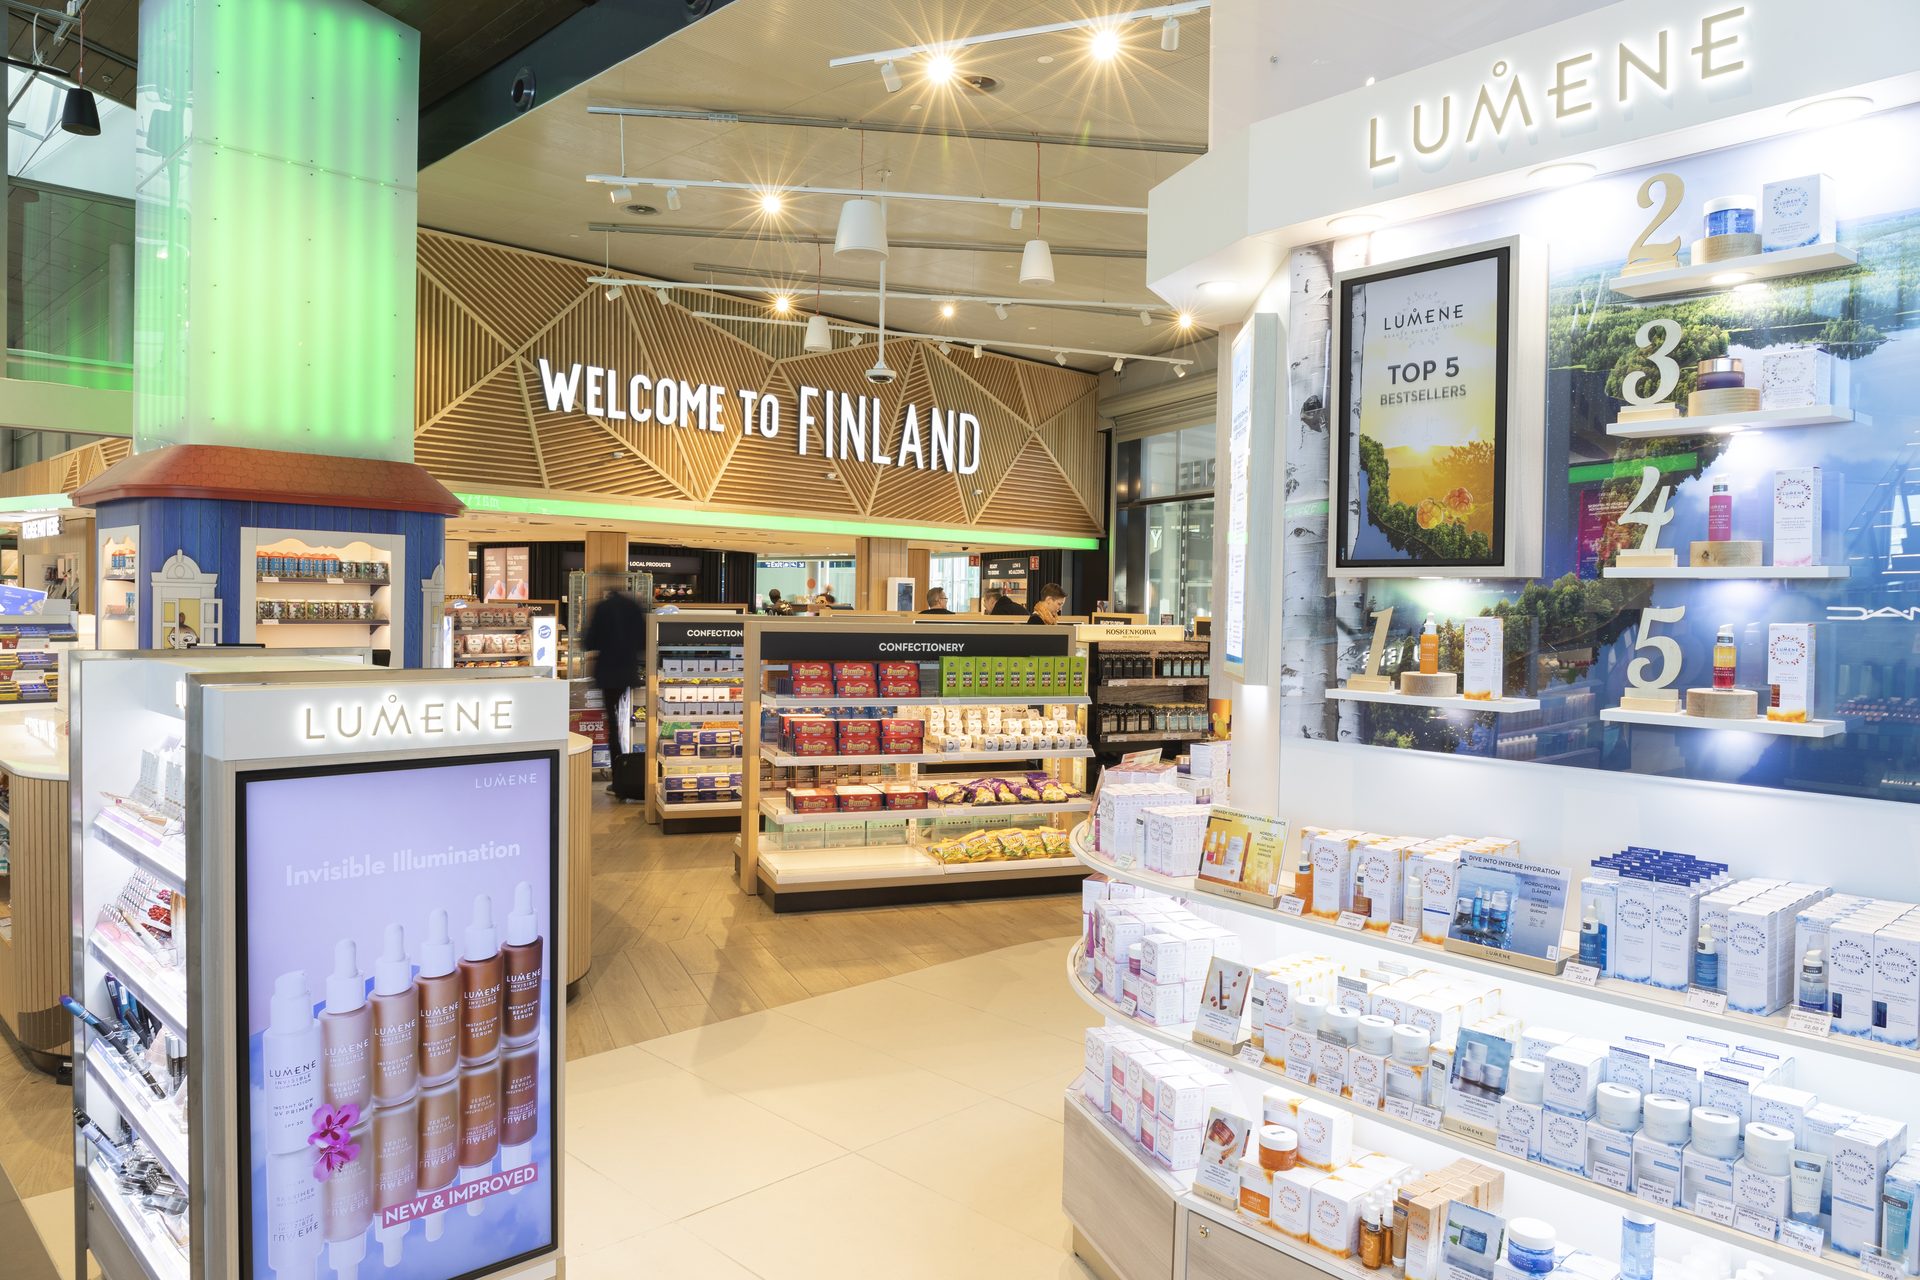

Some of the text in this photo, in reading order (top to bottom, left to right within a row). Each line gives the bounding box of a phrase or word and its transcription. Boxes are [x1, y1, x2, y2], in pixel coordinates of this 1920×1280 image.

[1369, 6, 1745, 169] LUMENE
[1629, 173, 1686, 263] 2
[1384, 304, 1463, 330] LUMENE
[1387, 356, 1460, 385] TOP 5
[1622, 319, 1682, 406] 3
[1380, 384, 1467, 406] BESTSELLERS
[538, 358, 982, 475] WELCOME TO FINLAND
[1618, 466, 1674, 553] 4
[1106, 628, 1157, 636] KOSKENKORVA
[878, 642, 965, 652] CONFECTIONERY
[1363, 606, 1395, 677] 1
[1626, 606, 1686, 690] 5
[306, 694, 513, 739] LUMENE
[579, 724, 604, 732] BOX
[475, 772, 538, 790] LUMENE
[287, 839, 521, 887] Invisible Illumination
[1483, 857, 1498, 865] INTO
[1498, 860, 1524, 870] INTENSE
[1524, 864, 1560, 876] HYDRATION
[1485, 950, 1511, 960] LUMENE
[1838, 952, 1863, 960] LUMENE
[1883, 961, 1909, 969] LUMENE
[506, 968, 541, 983] LUMENE
[510, 979, 538, 989] INVISIBLE
[464, 984, 500, 999] LUMENE
[468, 995, 497, 1006] INVISIBLE
[421, 1002, 459, 1017] LUMENE
[512, 1006, 534, 1016] BEAUTY
[513, 1012, 533, 1021] SERUM
[374, 1019, 416, 1036] LUMENE
[470, 1024, 494, 1033] BEAUTY
[472, 1030, 492, 1039] SERUM
[324, 1038, 369, 1056] LUMENE
[269, 1060, 317, 1078] LUMENE
[1459, 1125, 1483, 1136] LUMENE
[1842, 1162, 1868, 1172] LUMENE
[386, 1167, 535, 1225] NEW & IMPROVED
